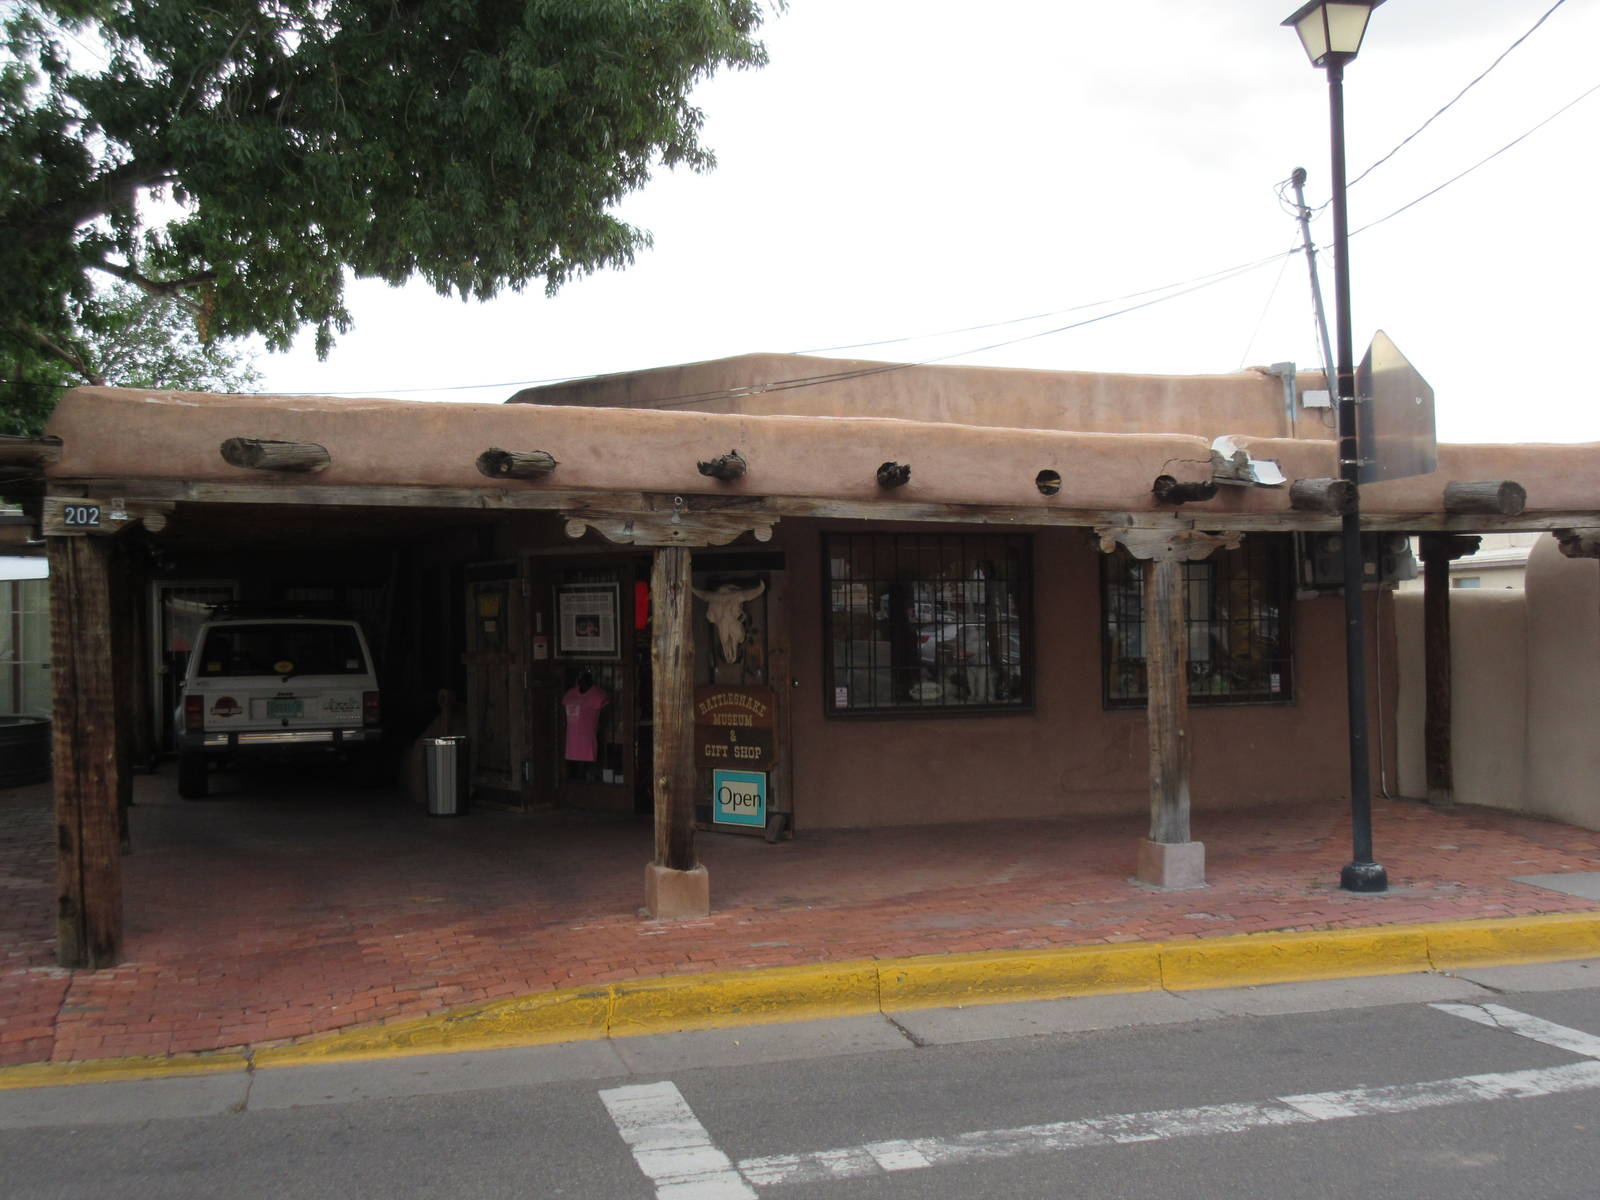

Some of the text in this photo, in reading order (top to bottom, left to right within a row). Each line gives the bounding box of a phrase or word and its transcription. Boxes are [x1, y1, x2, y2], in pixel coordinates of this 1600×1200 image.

[65, 507, 99, 524] 202
[699, 693, 767, 717] RATTLESNAKE
[713, 712, 753, 727] MUSEUM
[730, 729, 737, 742] &
[705, 744, 761, 759] GIFT SHOP
[718, 786, 762, 811] Open
